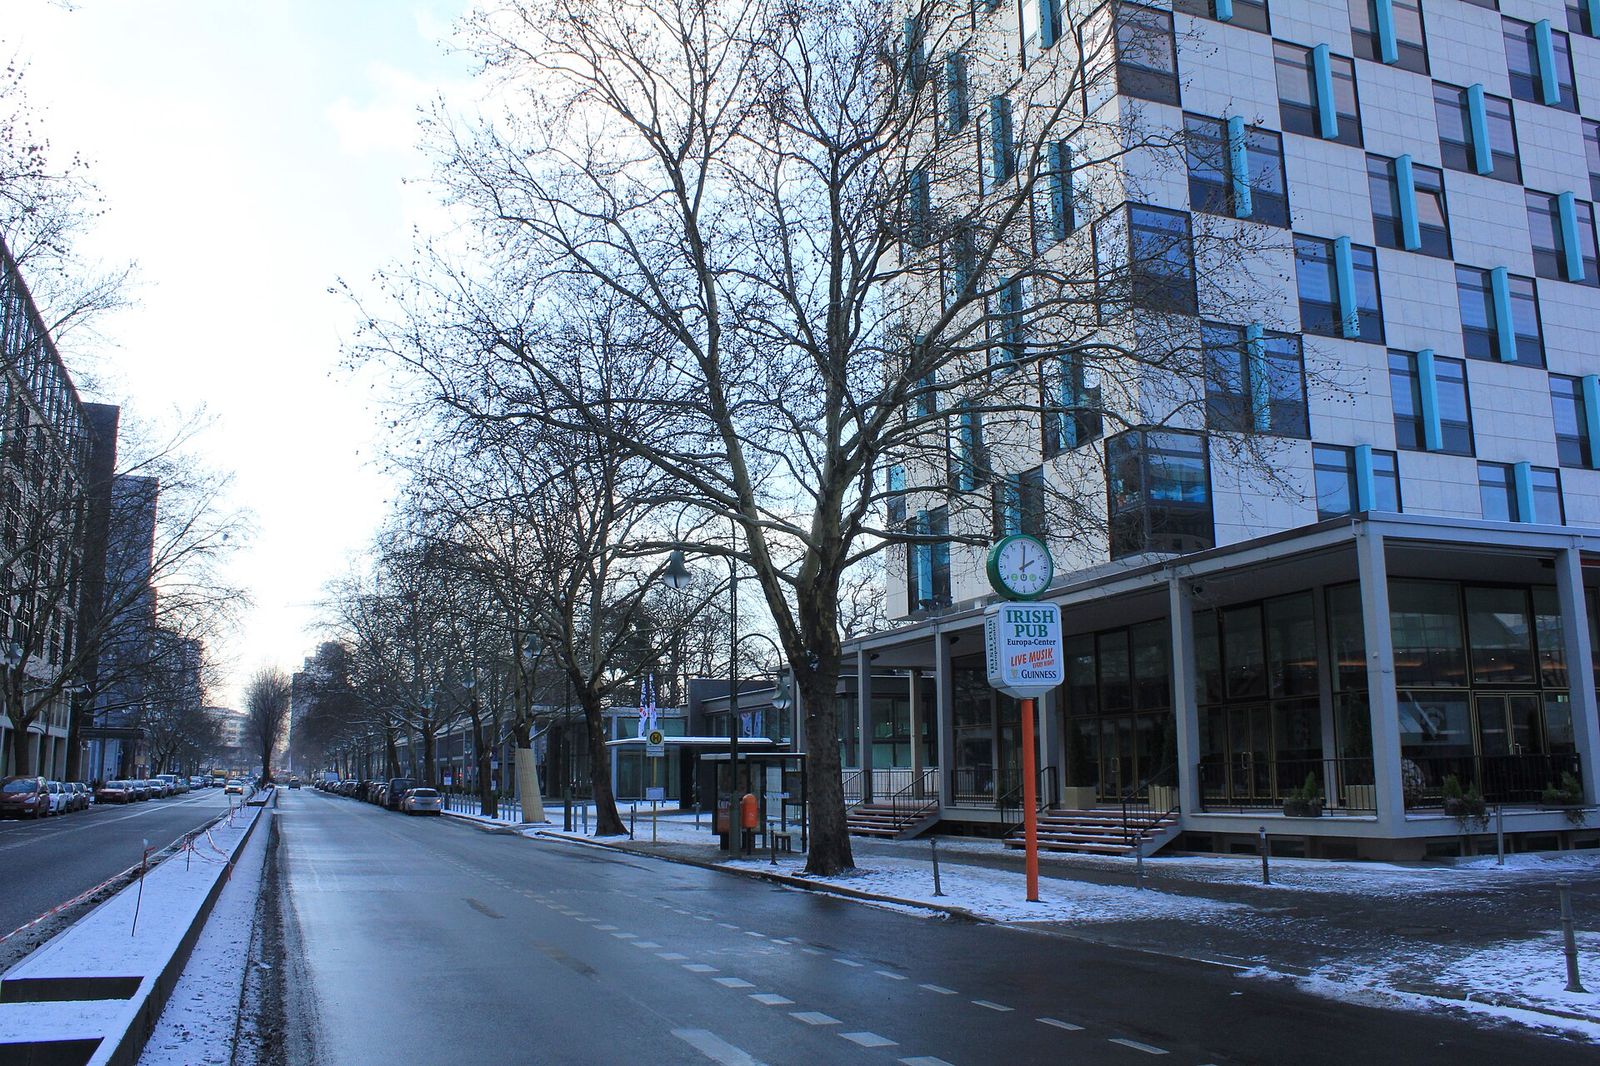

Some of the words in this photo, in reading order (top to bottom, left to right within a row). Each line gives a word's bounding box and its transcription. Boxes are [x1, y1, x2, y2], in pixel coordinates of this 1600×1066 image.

[1006, 610, 1055, 623] IRISH
[1015, 624, 1048, 637] PUB
[1010, 654, 1027, 666] LIVE
[1029, 648, 1053, 662] MUSIK
[1021, 670, 1056, 678] GUINNESS
